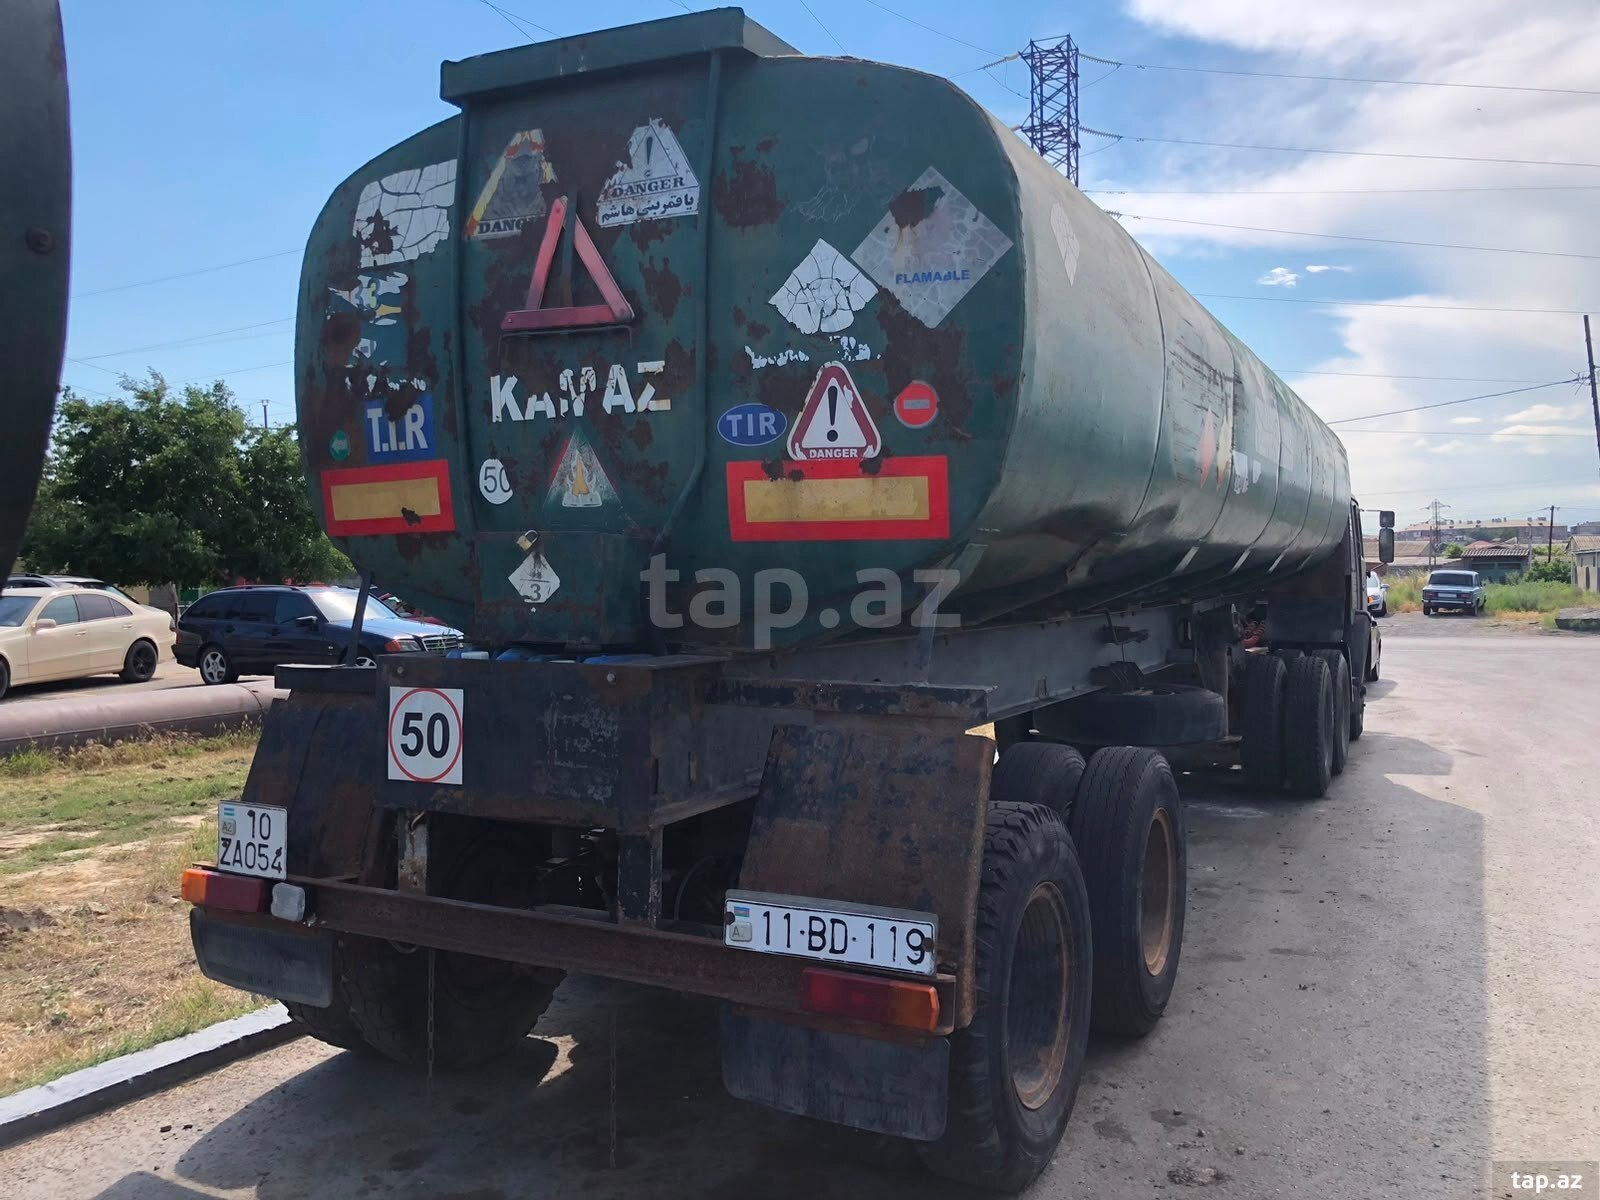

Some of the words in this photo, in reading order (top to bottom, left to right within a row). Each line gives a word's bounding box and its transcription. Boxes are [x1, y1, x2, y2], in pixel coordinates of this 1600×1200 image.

[611, 176, 685, 198] DANGER
[726, 412, 777, 438] TIR
[809, 448, 859, 459] DANGER
[529, 583, 542, 602] 3
[400, 712, 450, 759] 50
[247, 810, 271, 840] 10
[220, 837, 283, 874] ZA054
